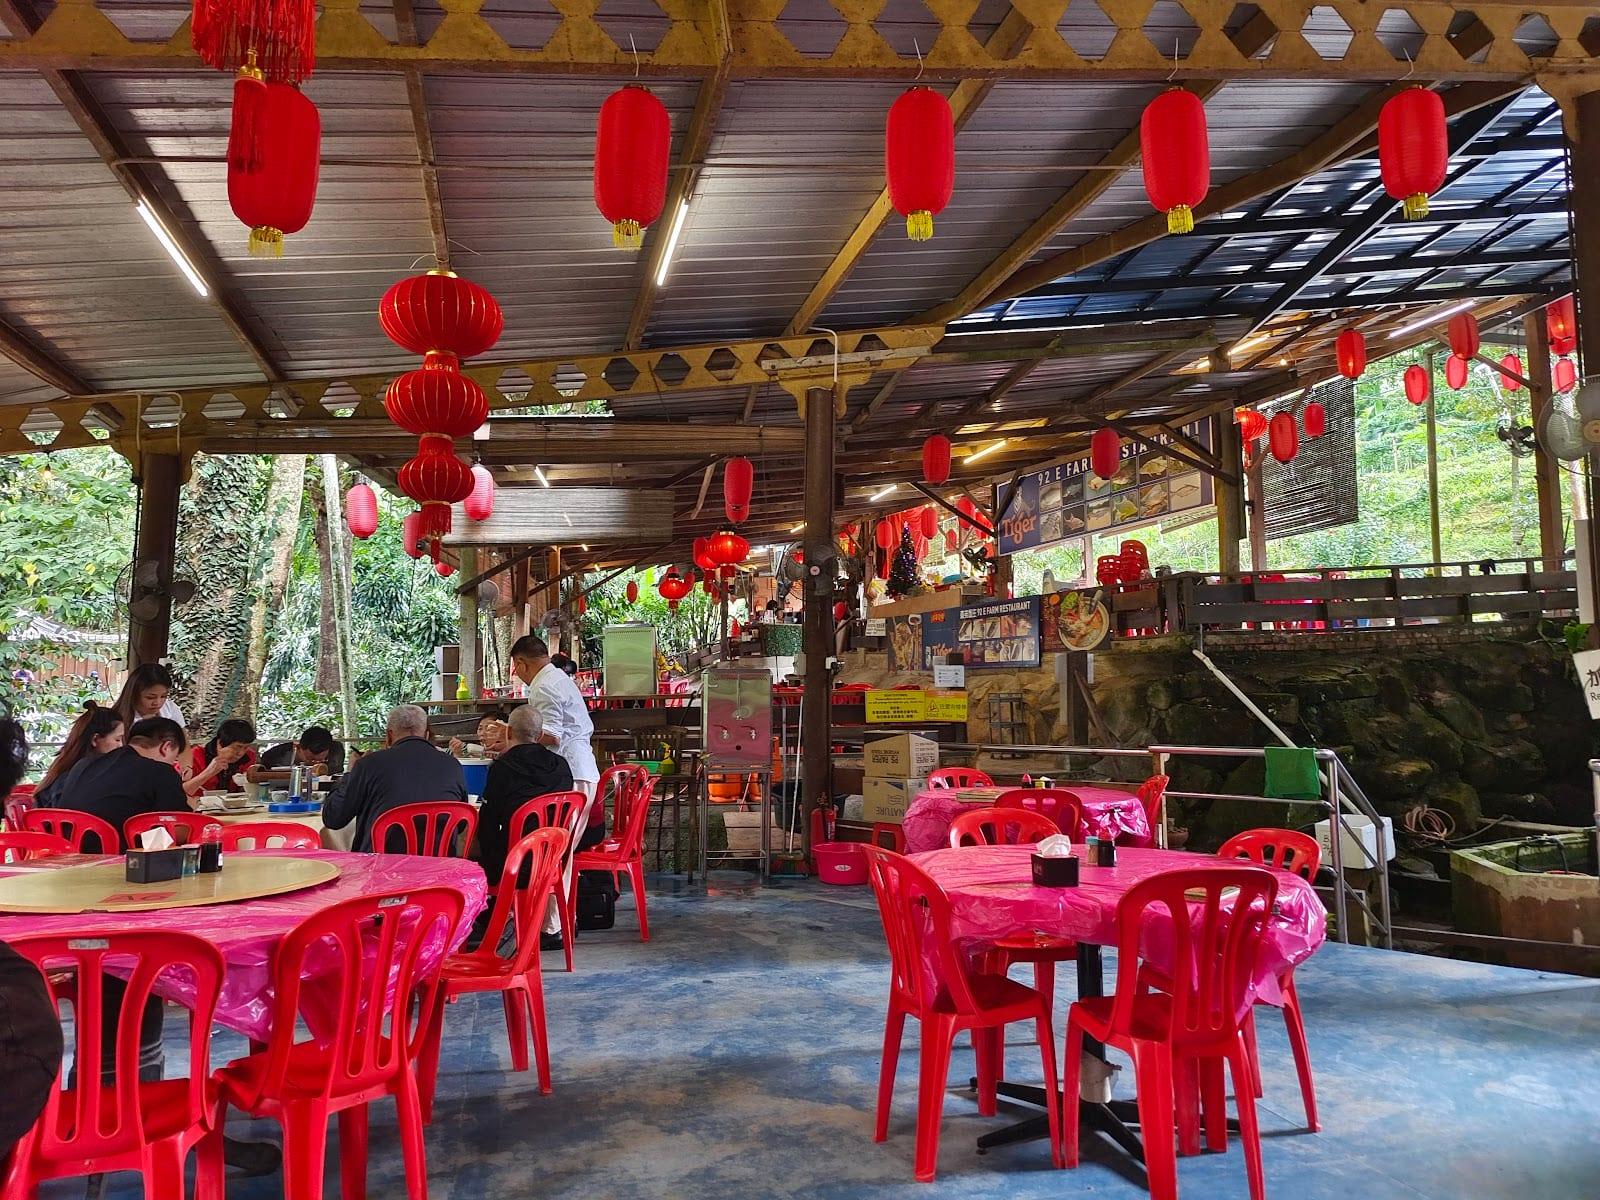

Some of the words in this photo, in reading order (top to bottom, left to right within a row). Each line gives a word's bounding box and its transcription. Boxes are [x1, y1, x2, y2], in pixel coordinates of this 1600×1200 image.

[1038, 470, 1050, 486] 92
[1055, 466, 1061, 480] E
[1002, 512, 1037, 544] Tiger
[987, 605, 999, 614] FARM
[1000, 601, 1031, 613] RESTAURANT
[875, 806, 905, 817] NATURE
